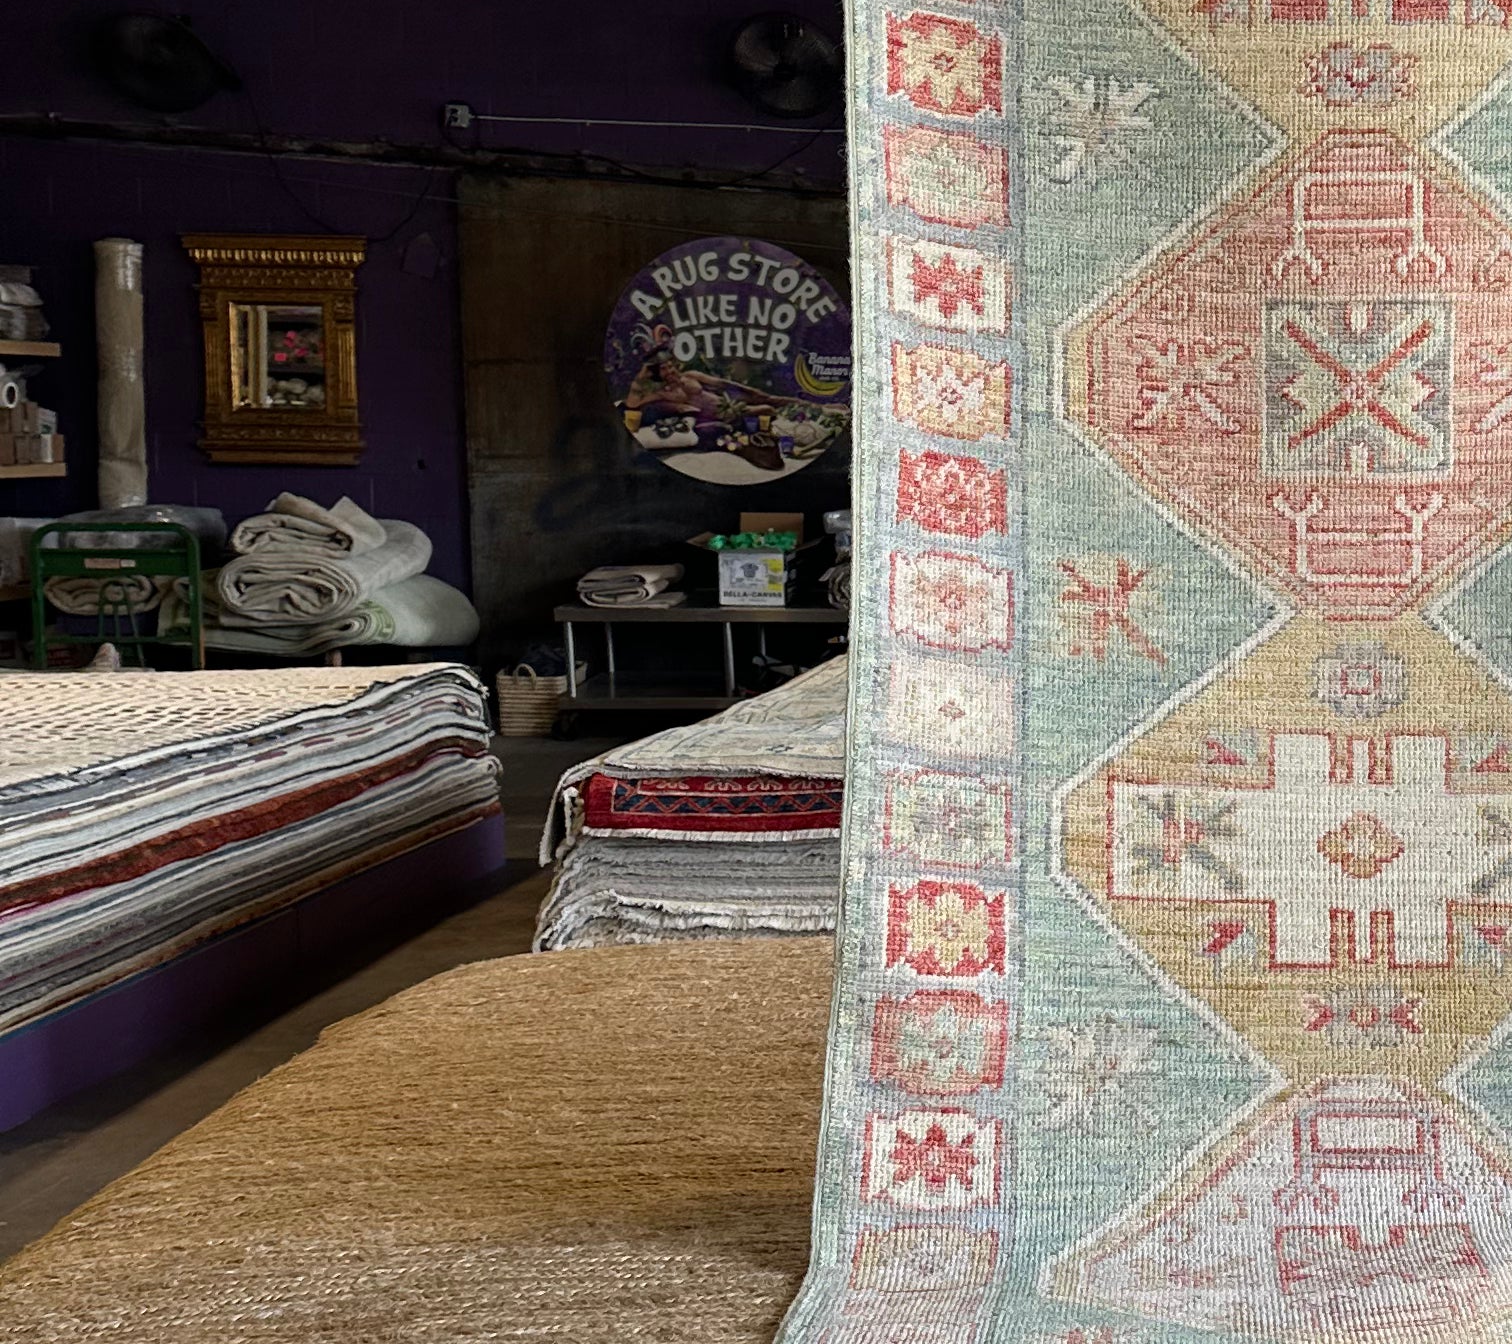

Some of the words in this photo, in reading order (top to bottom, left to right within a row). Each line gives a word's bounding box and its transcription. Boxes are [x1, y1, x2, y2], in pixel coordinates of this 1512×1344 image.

[630, 289, 662, 320] A
[651, 251, 719, 298] RUG
[727, 252, 837, 324] STORE
[668, 294, 738, 329] LIKE
[747, 296, 796, 330] NO
[673, 326, 790, 363] OTHER
